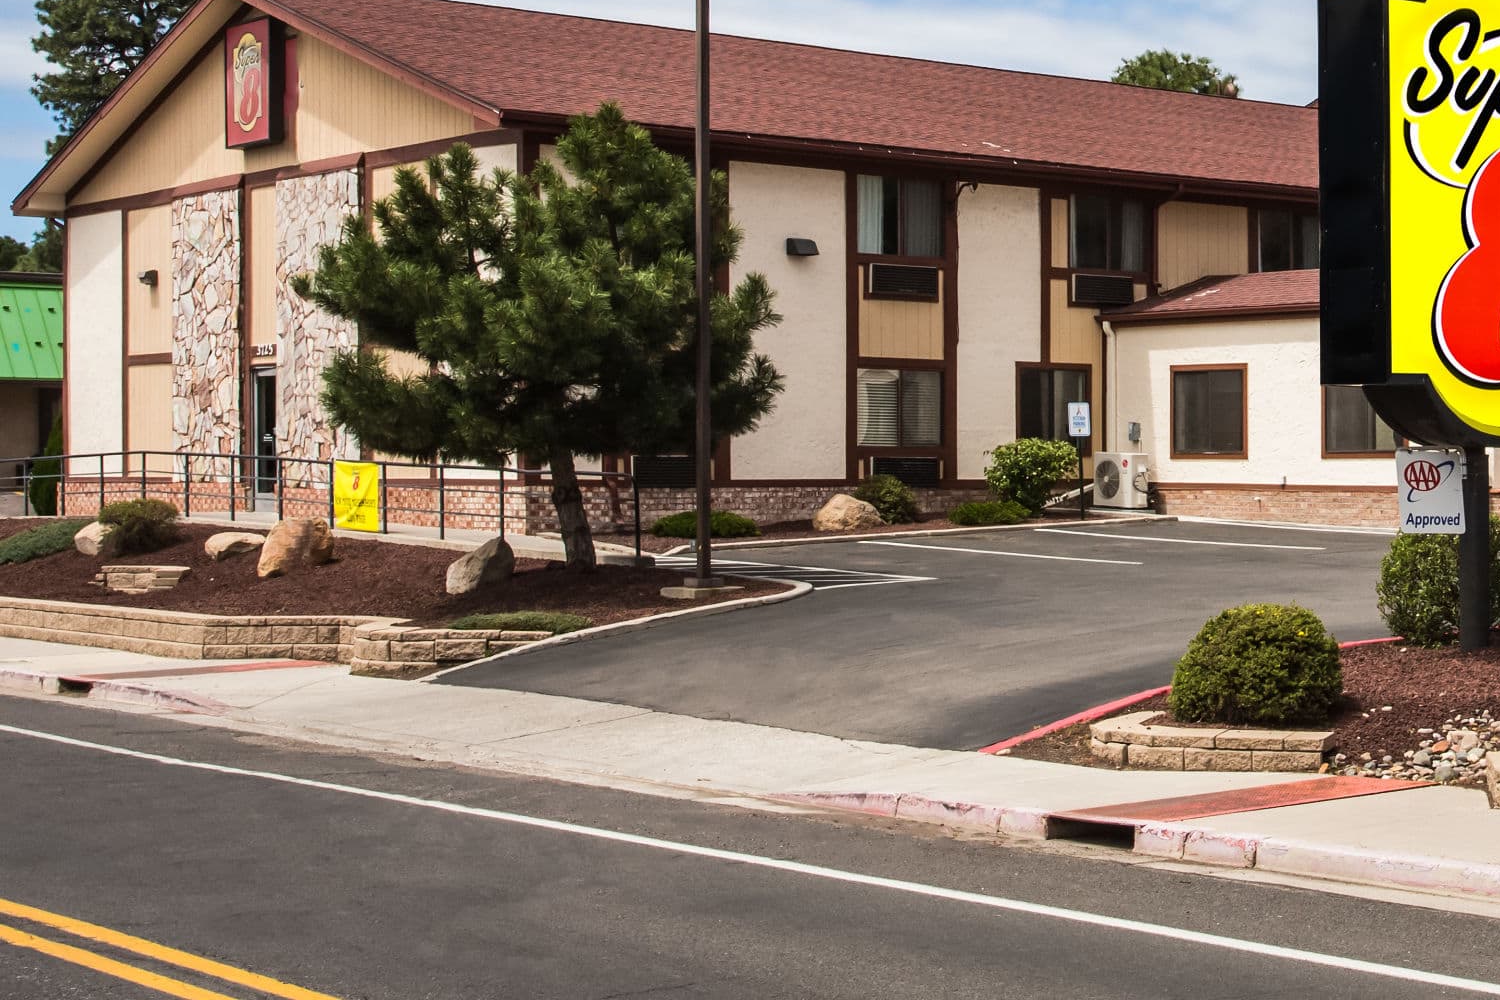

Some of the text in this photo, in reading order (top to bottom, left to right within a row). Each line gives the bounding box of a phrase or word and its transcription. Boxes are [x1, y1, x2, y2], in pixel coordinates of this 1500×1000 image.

[235, 47, 260, 79] Super
[240, 68, 260, 125] 8
[1407, 461, 1438, 490] AAA
[1406, 512, 1460, 528] Approved
